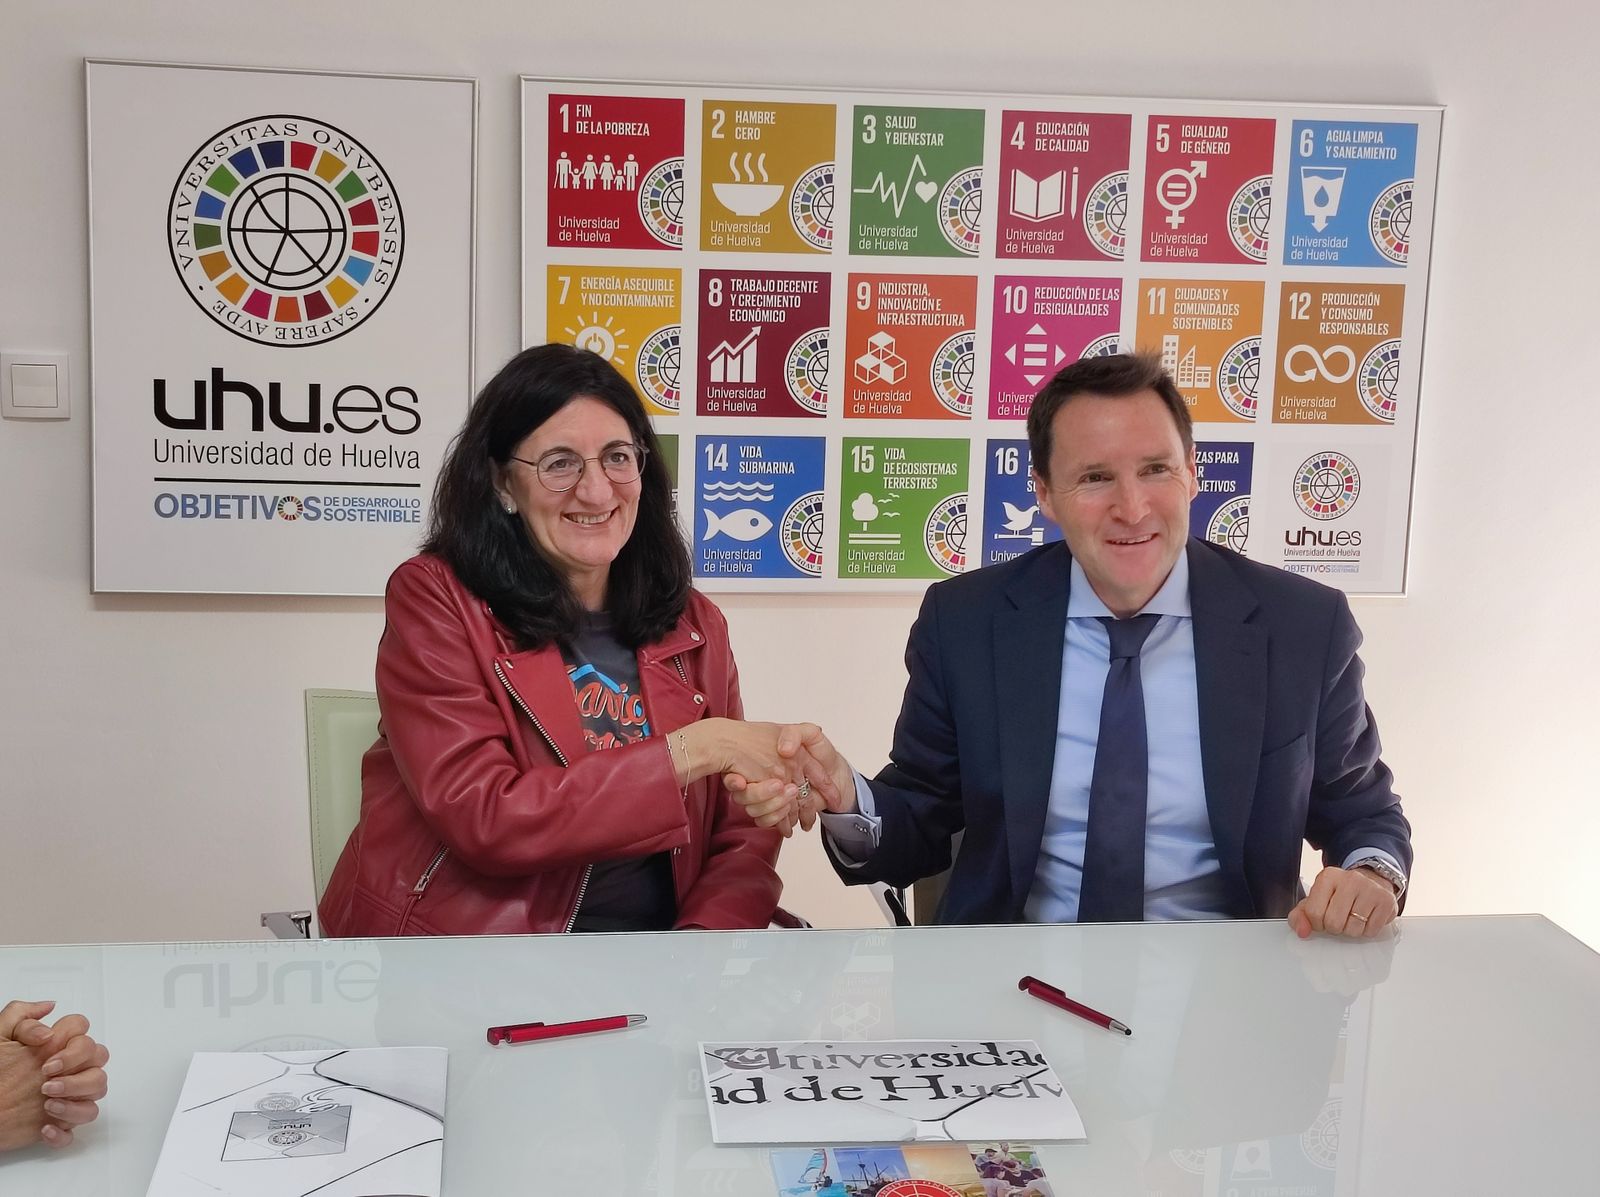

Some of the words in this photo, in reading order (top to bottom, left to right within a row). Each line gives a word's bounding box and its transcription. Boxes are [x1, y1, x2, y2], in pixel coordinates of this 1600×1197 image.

[560, 103, 569, 133] 1
[576, 104, 592, 118] FIN
[735, 110, 776, 125] HAMBRE
[576, 122, 588, 134] DE
[590, 122, 603, 134] LA
[604, 122, 650, 136] POBREZA
[712, 109, 724, 138] 2
[862, 114, 876, 144] 3
[886, 116, 916, 129] SALUD
[1036, 121, 1089, 136] EDUCACIÓN
[735, 127, 760, 140] CERO
[885, 132, 892, 144] Y
[894, 132, 944, 146] BIENESTAR
[1010, 122, 1025, 150] 4
[1156, 124, 1170, 152] 5
[1182, 125, 1228, 139] IGUALDAD
[1326, 130, 1351, 142] AGUA
[1352, 130, 1383, 144] LIMPIA
[1036, 139, 1048, 151] DE
[1049, 139, 1089, 152] CALIDAD
[1181, 142, 1193, 154] DE
[1194, 140, 1230, 155] GÉNERO
[1300, 128, 1314, 157] 6
[1326, 146, 1332, 158] Y
[1333, 146, 1397, 160] SANEAMIENTO
[175, 122, 298, 270] VNIVERSITAS
[312, 130, 399, 286] ONVBENSIS
[558, 216, 620, 230] Universidad
[710, 220, 770, 234] Universidad
[559, 229, 572, 241] de
[575, 230, 610, 242] Huelva
[859, 224, 918, 237] Universidad
[1006, 228, 1064, 242] Universidad
[711, 234, 723, 246] de
[726, 234, 761, 247] Huelva
[859, 238, 871, 249] de
[875, 238, 908, 250] Huelva
[1151, 232, 1208, 245] Universidad
[1292, 236, 1348, 248] Universidad
[1006, 242, 1018, 253] de
[1022, 242, 1054, 254] Huelva
[1150, 246, 1162, 256] de
[1166, 246, 1198, 258] Huelva
[1291, 249, 1302, 260] de
[1306, 250, 1338, 261] Huelva
[558, 276, 570, 304] 7
[581, 276, 622, 290] ENERGÍA
[624, 278, 674, 292] ASEQUIBLE
[730, 278, 776, 292] TRABAJO
[776, 280, 818, 294] DECENTE
[708, 278, 723, 307] 8
[856, 282, 871, 310] 9
[1035, 286, 1088, 300] REDUCCIÓN
[1089, 288, 1100, 300] DE
[1102, 288, 1120, 301] LAS
[1175, 288, 1220, 301] CIUDADES
[1221, 289, 1228, 300] Y
[1322, 292, 1380, 306] PRODUCCIÓN
[581, 293, 588, 304] Y
[588, 294, 602, 306] NO
[603, 294, 674, 308] CONTAMINANTE
[730, 294, 738, 307] Y
[738, 294, 800, 308] CRECIMIENTO
[878, 296, 934, 310] INNOVACIÓN
[936, 299, 942, 311] E
[1003, 286, 1028, 314] 10
[1147, 288, 1166, 315] 11
[1289, 292, 1310, 320] 12
[730, 307, 786, 322] ECONÓMICO
[1034, 302, 1109, 316] DESIGUALDADES
[1174, 303, 1240, 316] COMUNIDADES
[1322, 308, 1328, 319] Y
[1328, 308, 1372, 320] CONSUMO
[213, 300, 268, 335] AVDE
[276, 307, 358, 340] SAPERE
[878, 313, 965, 326] INFRAESTRUCTURA
[1173, 318, 1232, 330] SOSTENIBLES
[1320, 322, 1389, 335] RESPONSABLES
[707, 387, 766, 400] Universidad
[854, 390, 911, 402] Universidad
[998, 392, 1037, 404] Univers
[154, 368, 421, 435] uhu.es
[708, 400, 720, 412] de
[723, 400, 757, 412] Huelva
[854, 402, 866, 414] de
[869, 402, 902, 414] Huelva
[1280, 396, 1336, 408] Universidad
[998, 405, 1010, 416] de
[1280, 409, 1292, 420] de
[1295, 410, 1326, 420] Huelva
[154, 438, 294, 466] Universidad
[304, 443, 331, 467] de
[342, 444, 420, 469] Huelva
[704, 444, 728, 472] 14
[740, 446, 762, 459] VIDA
[851, 445, 874, 472] 15
[884, 448, 906, 461] VIDA
[1215, 452, 1239, 464] PARA
[739, 461, 795, 474] SUBMARINA
[995, 448, 1019, 475] 16
[884, 462, 895, 474] DE
[896, 463, 958, 476] ECOSISTEMAS
[883, 477, 938, 490] TERRESTRES
[1198, 480, 1236, 492] JETIVOS
[154, 493, 322, 521] OBJETIVOS
[324, 497, 340, 507] DE
[343, 498, 420, 509] DESARROLLO
[324, 509, 420, 523] SOSTENIBLE
[1285, 526, 1361, 546] uhu.es
[703, 548, 762, 561] Universidad
[848, 550, 905, 562] Universidad
[1284, 548, 1324, 556] Universidad
[1337, 549, 1360, 557] Huelva
[704, 562, 716, 572] de
[719, 562, 752, 572] Huelva
[848, 562, 860, 572] de
[863, 562, 896, 574] Huelva
[784, 1076, 864, 1102] de
